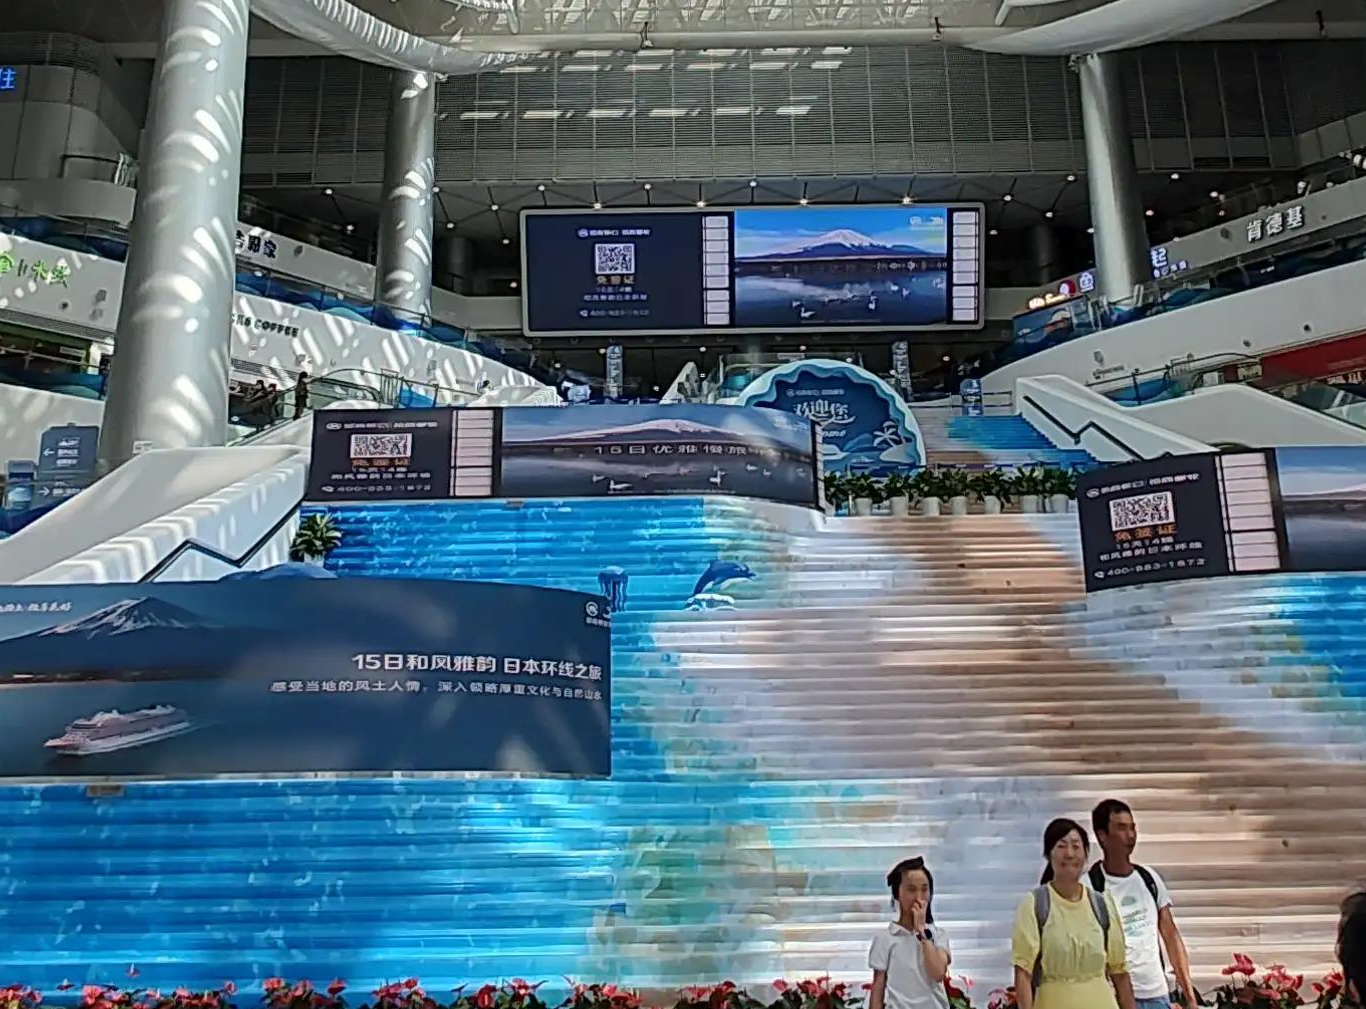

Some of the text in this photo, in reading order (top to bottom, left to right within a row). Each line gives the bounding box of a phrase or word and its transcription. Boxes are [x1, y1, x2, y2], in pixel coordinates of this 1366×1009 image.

[1245, 205, 1305, 243] 肯德基
[503, 656, 603, 682] 日本环线之旅
